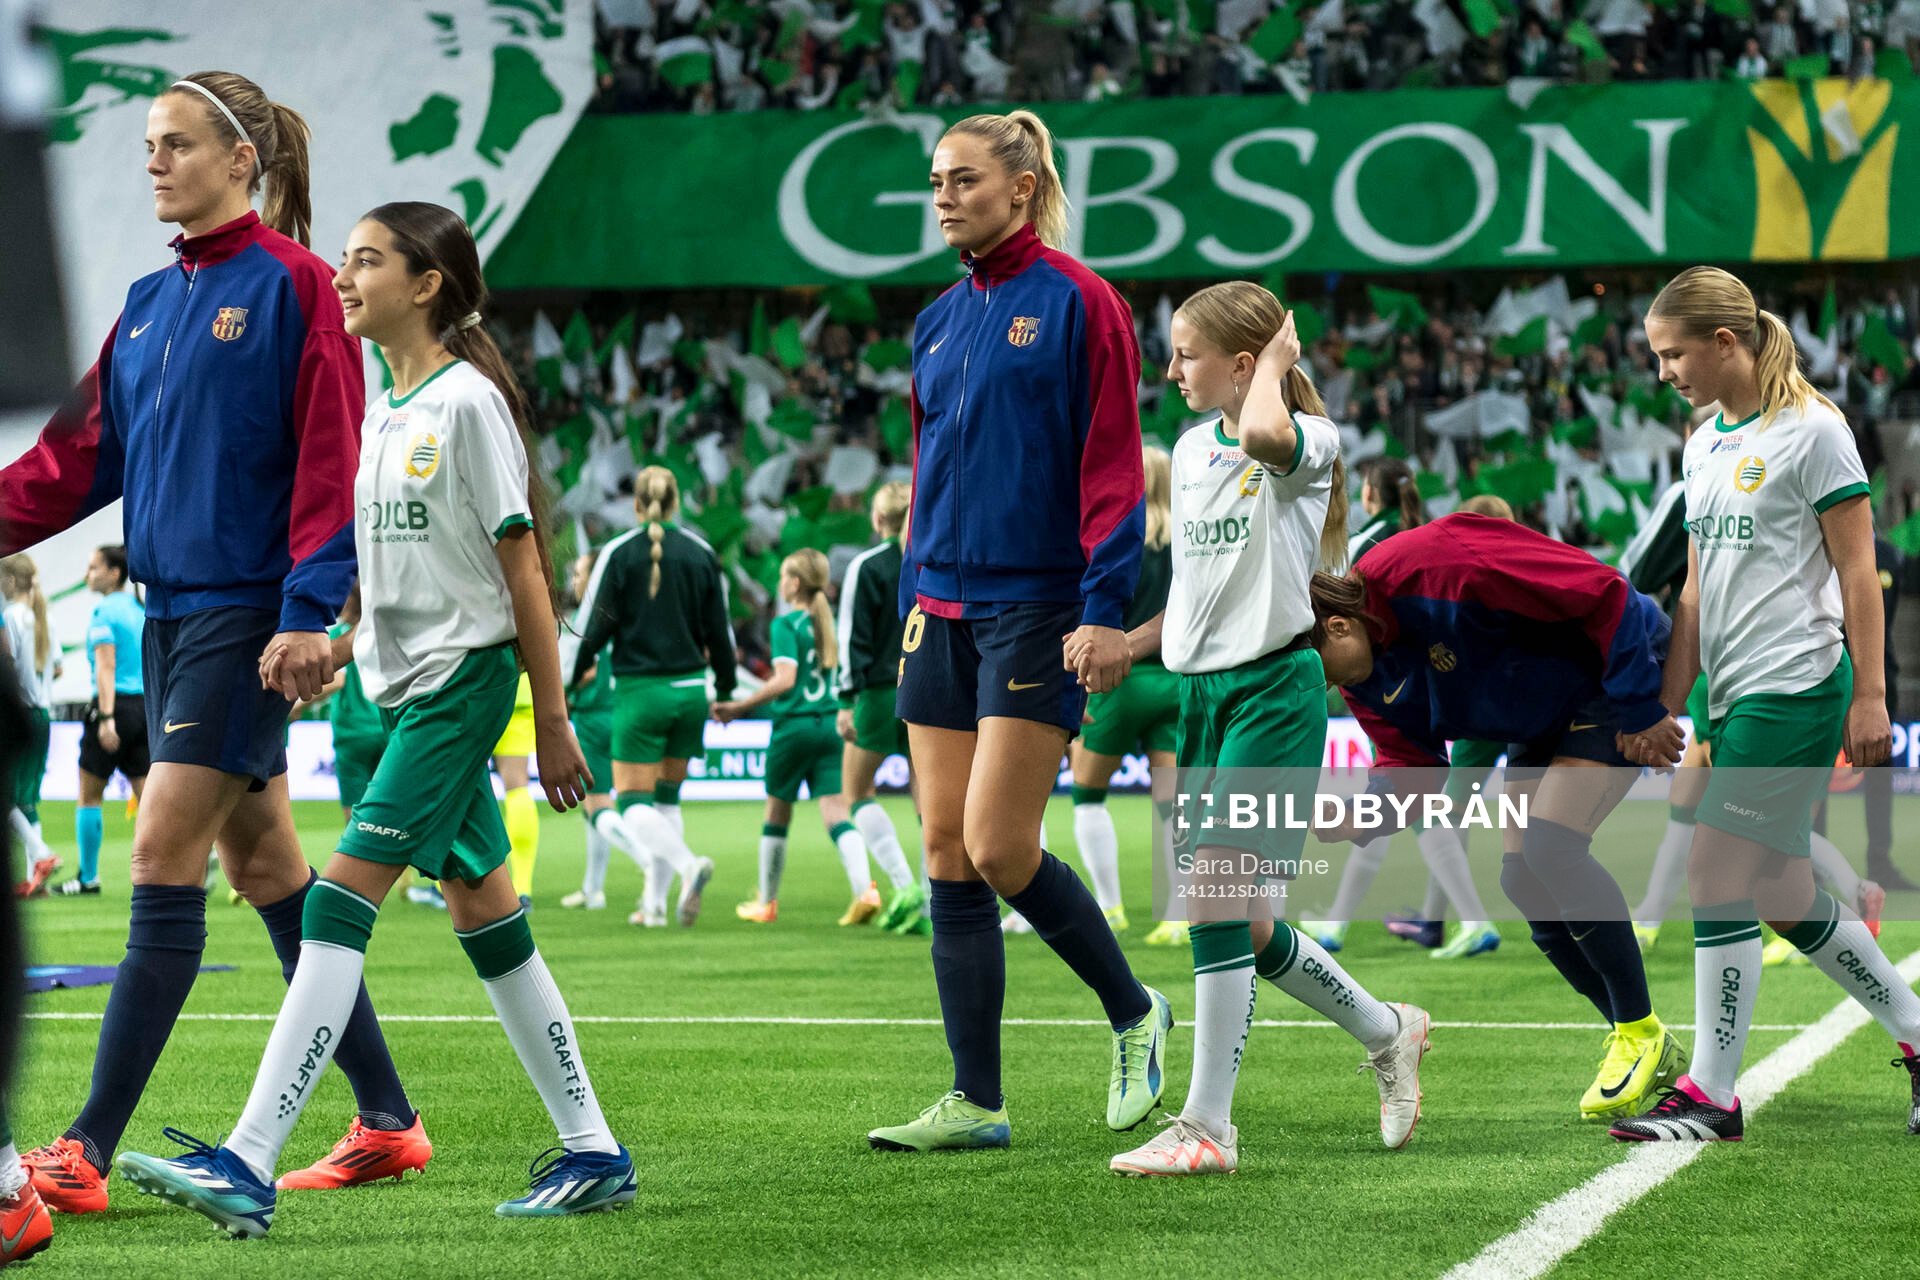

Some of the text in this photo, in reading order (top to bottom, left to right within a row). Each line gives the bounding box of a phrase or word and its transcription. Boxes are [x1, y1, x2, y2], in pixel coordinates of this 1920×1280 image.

[777, 112, 1690, 278] GBSON
[358, 821, 401, 838] CRAFT
[1723, 802, 1758, 818] CRAFT
[1302, 957, 1345, 996] CRAFT
[1836, 949, 1882, 991] CRAFT
[1720, 966, 1741, 1030] CRAFT
[290, 1025, 333, 1100] CRAFT
[547, 1021, 581, 1083] CRAFT
